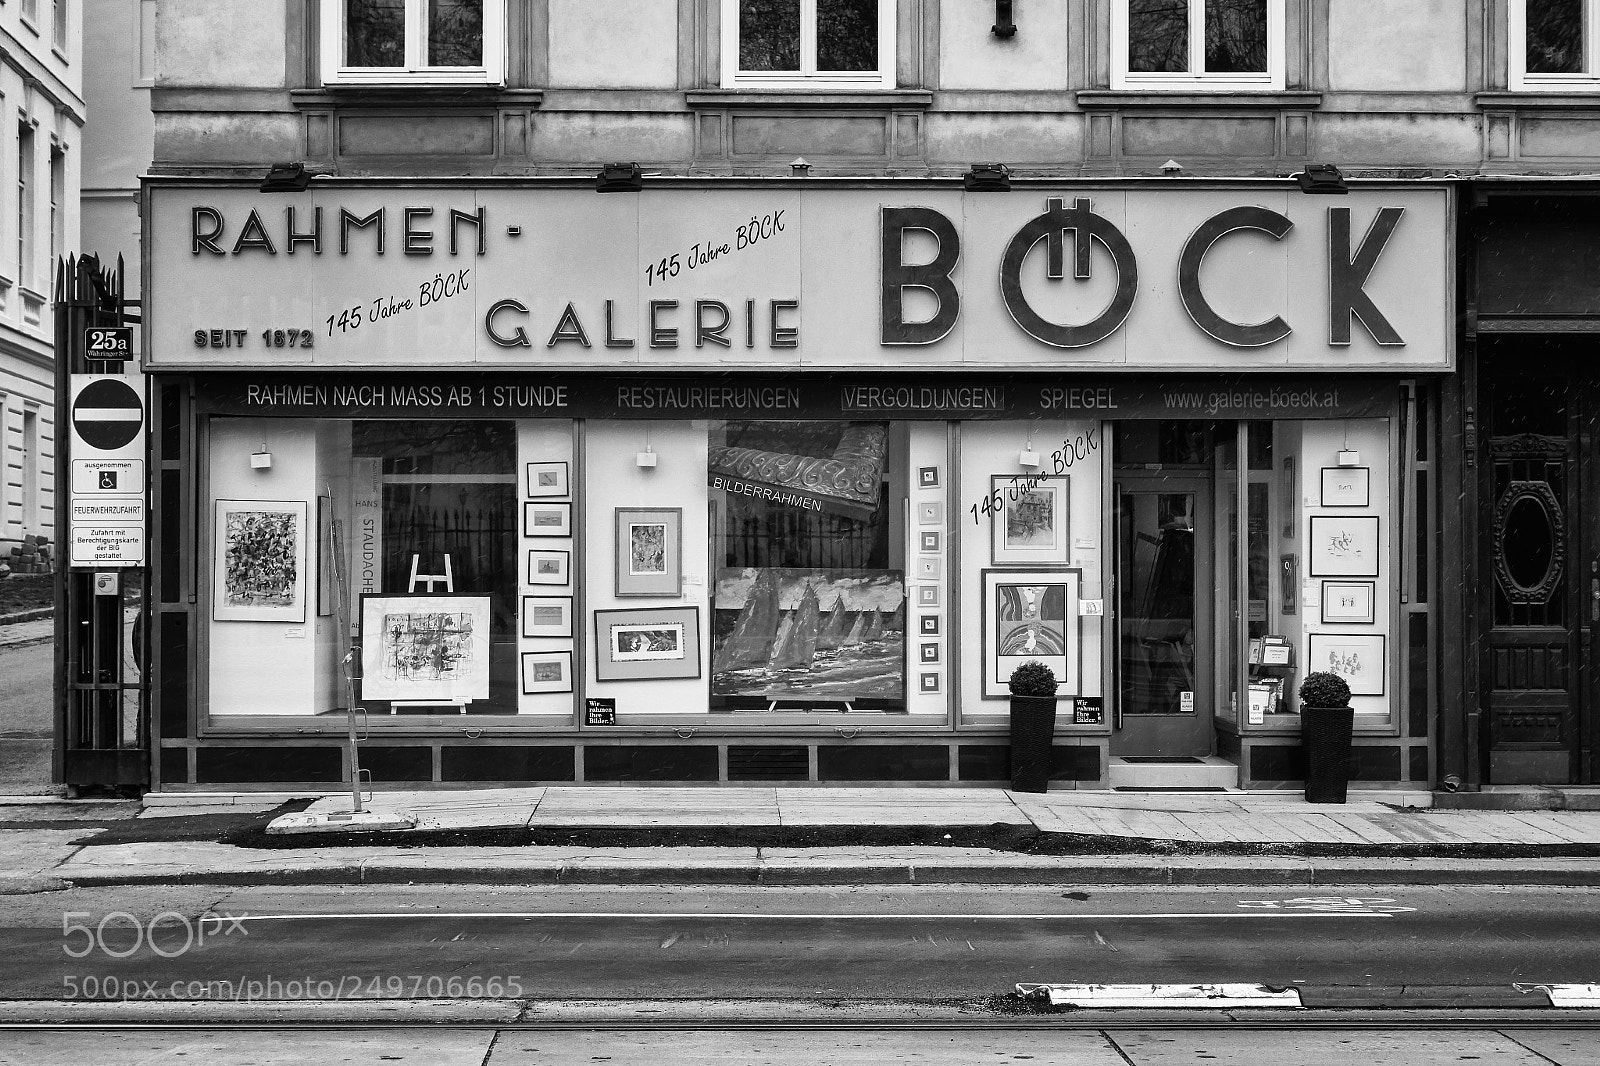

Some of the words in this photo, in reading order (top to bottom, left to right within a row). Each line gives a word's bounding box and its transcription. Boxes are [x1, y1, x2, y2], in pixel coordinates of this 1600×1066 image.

[645, 253, 681, 287] 145
[687, 241, 731, 270] Jahre
[735, 209, 785, 251] BÖCK
[879, 196, 1407, 349] BÖCK
[326, 305, 362, 337] 145
[369, 295, 414, 323] Jahre
[419, 268, 470, 308] BÖCK
[485, 298, 799, 348] GALERIE
[91, 331, 128, 350] 25a
[193, 328, 248, 349] SEIT
[262, 328, 314, 349] 1872
[247, 384, 327, 406] RAHMEN
[333, 385, 385, 406] NACH
[390, 385, 442, 407] MASS
[447, 386, 472, 407] AB
[478, 386, 486, 407] 1
[492, 386, 568, 407] STUNDE
[616, 386, 800, 408] RESTAURIERUNGEN
[843, 387, 997, 409] VERGOLDUNGEN
[1040, 388, 1118, 409] SPIEGEL
[1163, 388, 1340, 414] www.galerie-boeck.at
[84, 462, 132, 470] ausgenommen
[970, 489, 1003, 525] 145
[1009, 471, 1049, 501] Jahre
[1050, 428, 1098, 476] BÖCK
[355, 500, 378, 508] HANS
[713, 477, 822, 512] BILDERRAHMEN
[74, 506, 141, 515] FEUERWEHRZUFAHRT
[77, 536, 139, 545] Berechtigungskarte
[94, 552, 122, 560] gestattet
